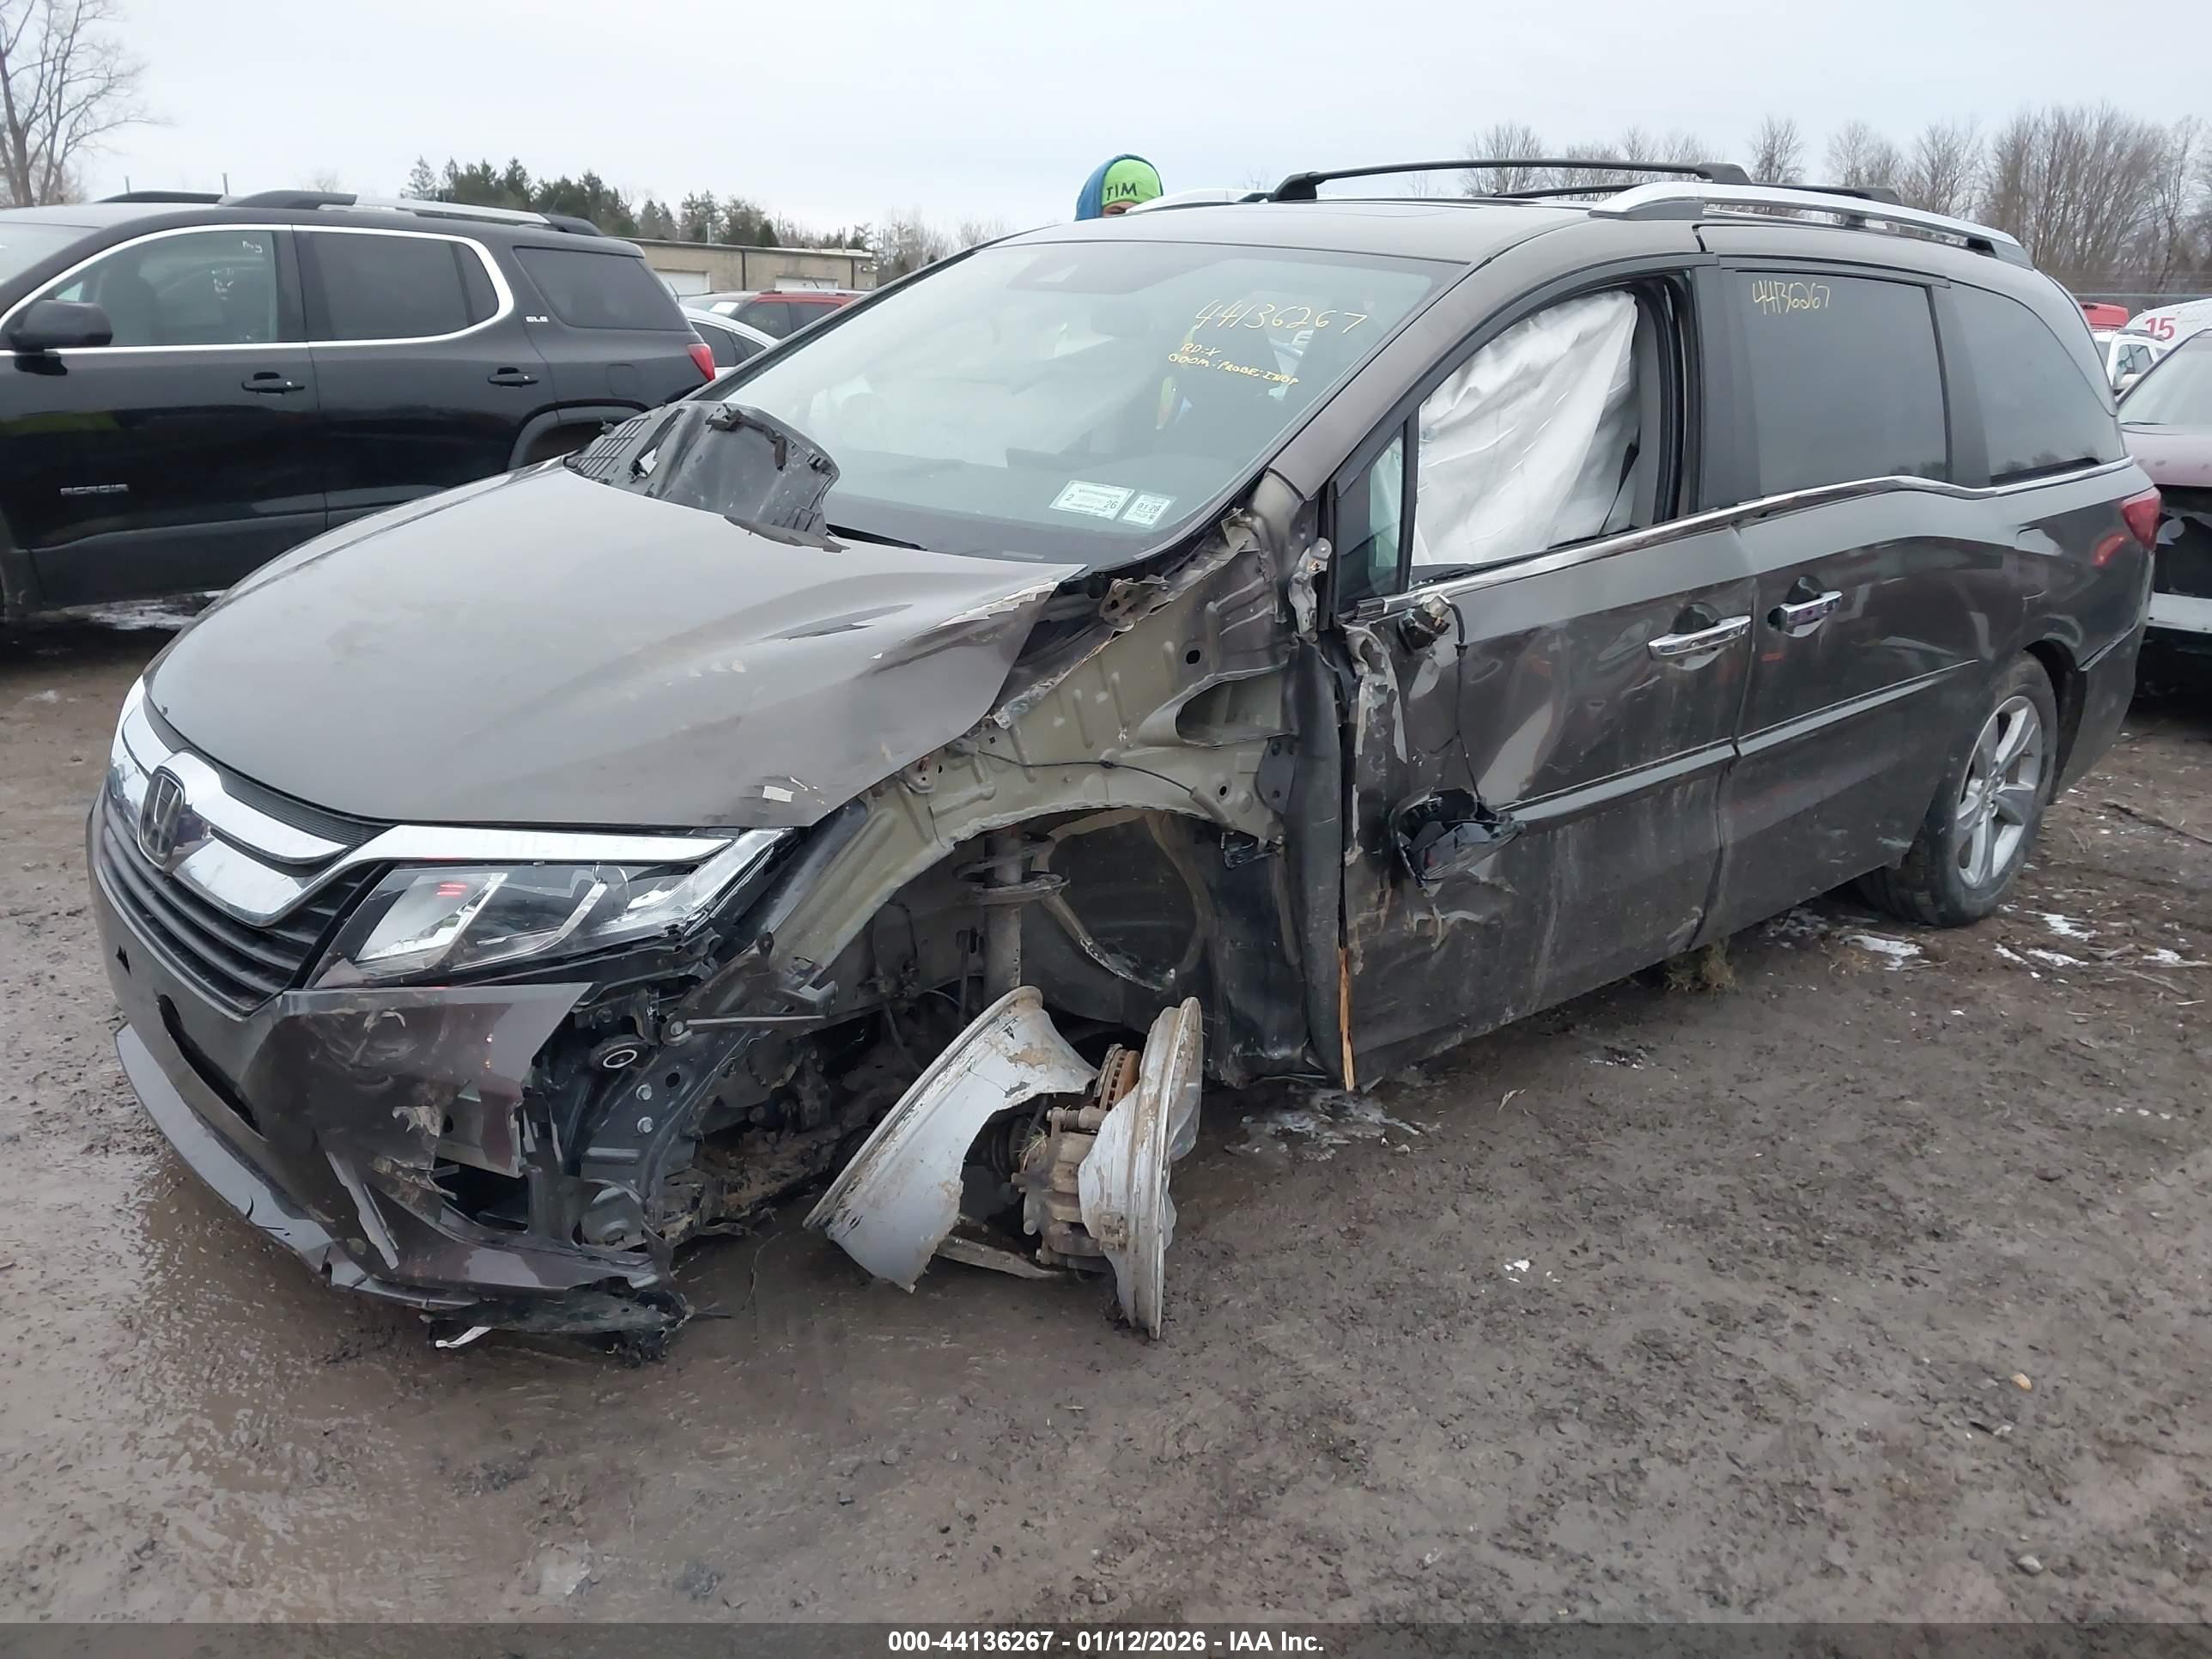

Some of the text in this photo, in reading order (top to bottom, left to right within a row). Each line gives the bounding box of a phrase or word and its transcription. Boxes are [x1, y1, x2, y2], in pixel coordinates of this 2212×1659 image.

[1106, 182, 1138, 201] TIM
[1752, 279, 1830, 315] 44136267
[1194, 299, 1368, 334] 44136267
[2145, 316, 2176, 341] 15
[1103, 500, 1119, 509] 26
